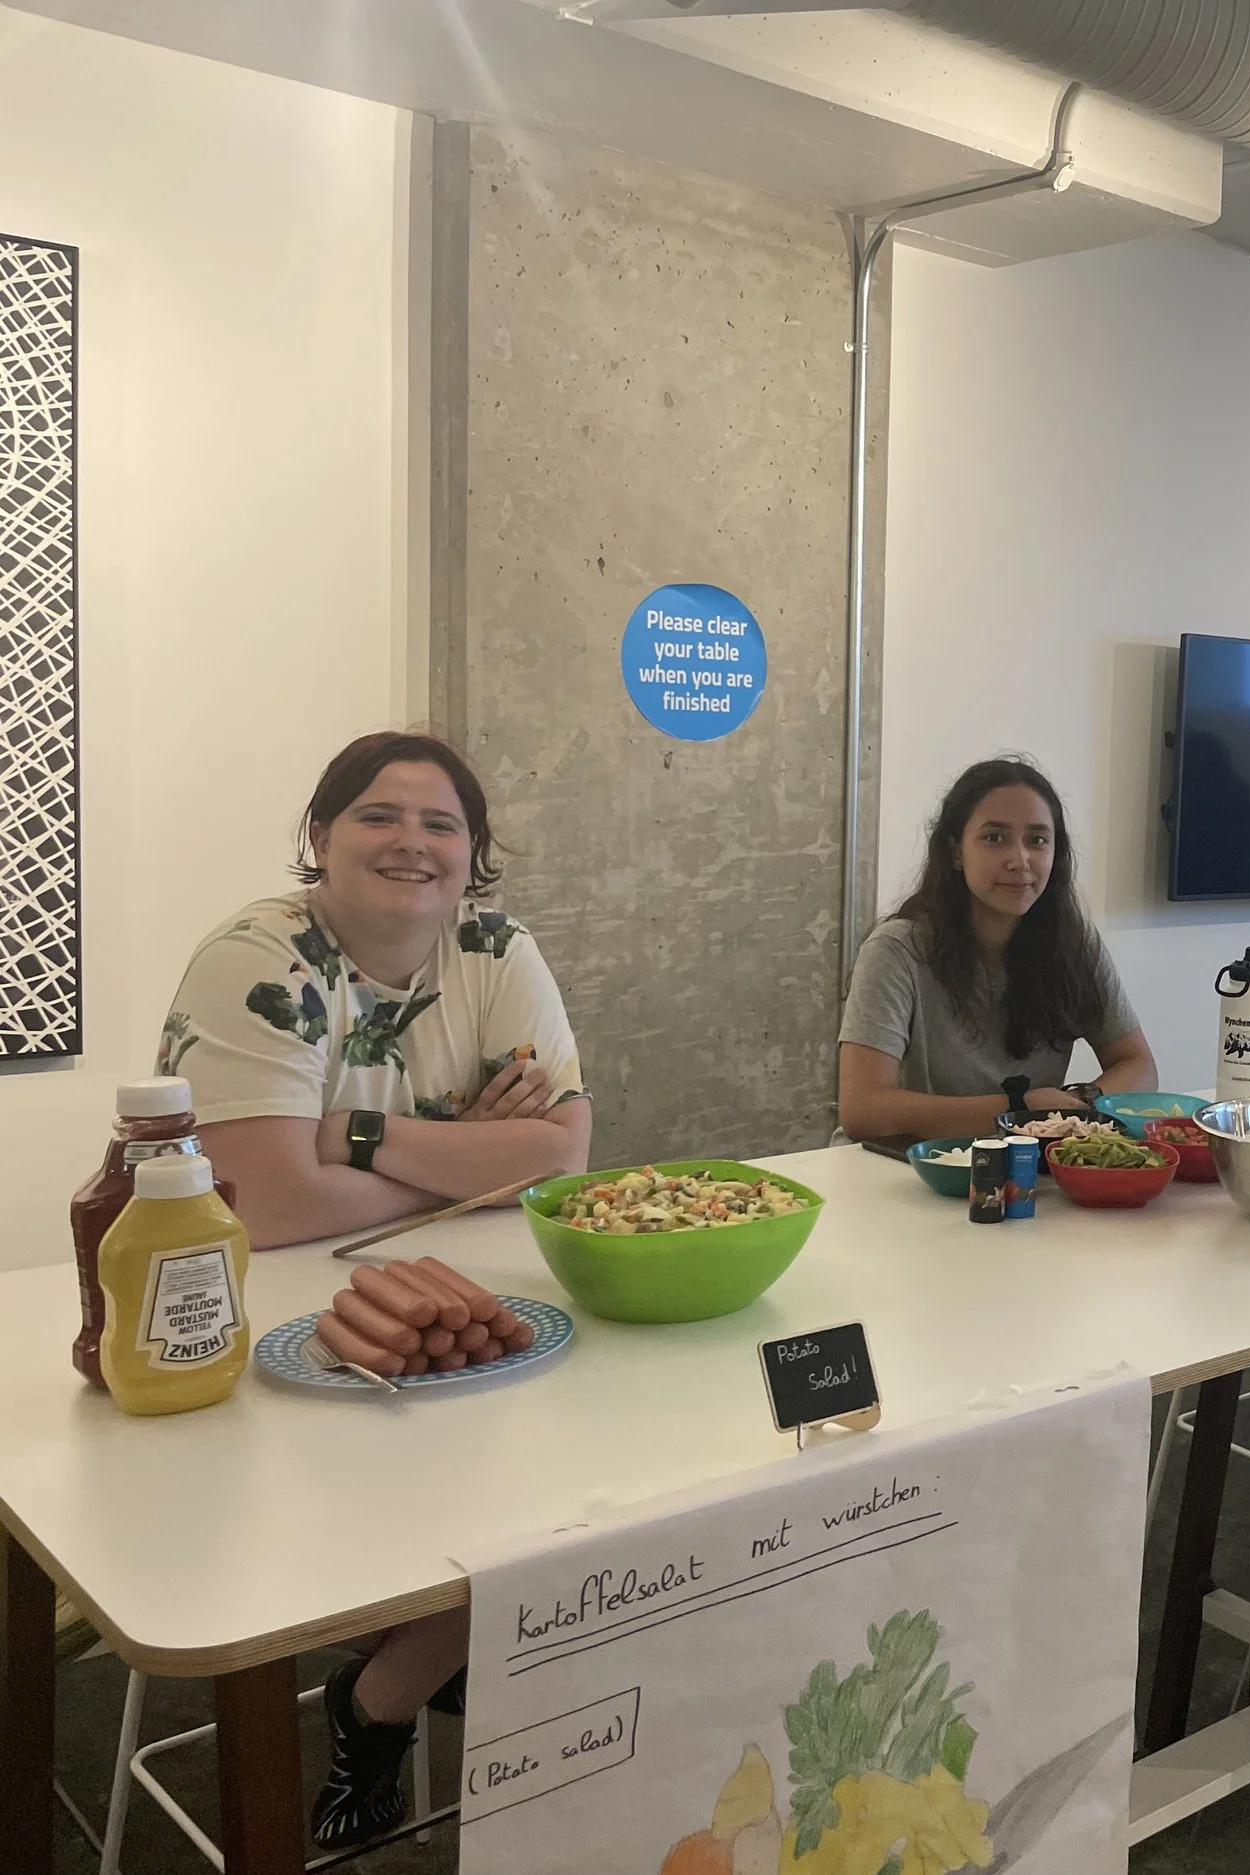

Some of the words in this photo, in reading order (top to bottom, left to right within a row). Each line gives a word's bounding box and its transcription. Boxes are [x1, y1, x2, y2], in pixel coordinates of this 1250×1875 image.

[646, 610, 703, 633] Please
[707, 615, 748, 636] clear
[654, 642, 693, 661] your
[698, 642, 739, 661] table
[639, 664, 687, 685] when
[692, 671, 722, 690] you
[727, 672, 753, 688] are
[663, 691, 731, 712] finished
[164, 1296, 222, 1316] MOUTARDE
[169, 1309, 219, 1328] MUSTARD
[178, 1321, 212, 1335] YELLOW
[168, 1336, 221, 1358] HEINZ
[777, 1339, 820, 1364] Potato
[809, 1354, 860, 1390] Salad!
[516, 1556, 705, 1643] Kartoffelsalat
[751, 1518, 793, 1559] mit
[468, 1757, 539, 1796] (Potato
[561, 1714, 624, 1760] salad)
